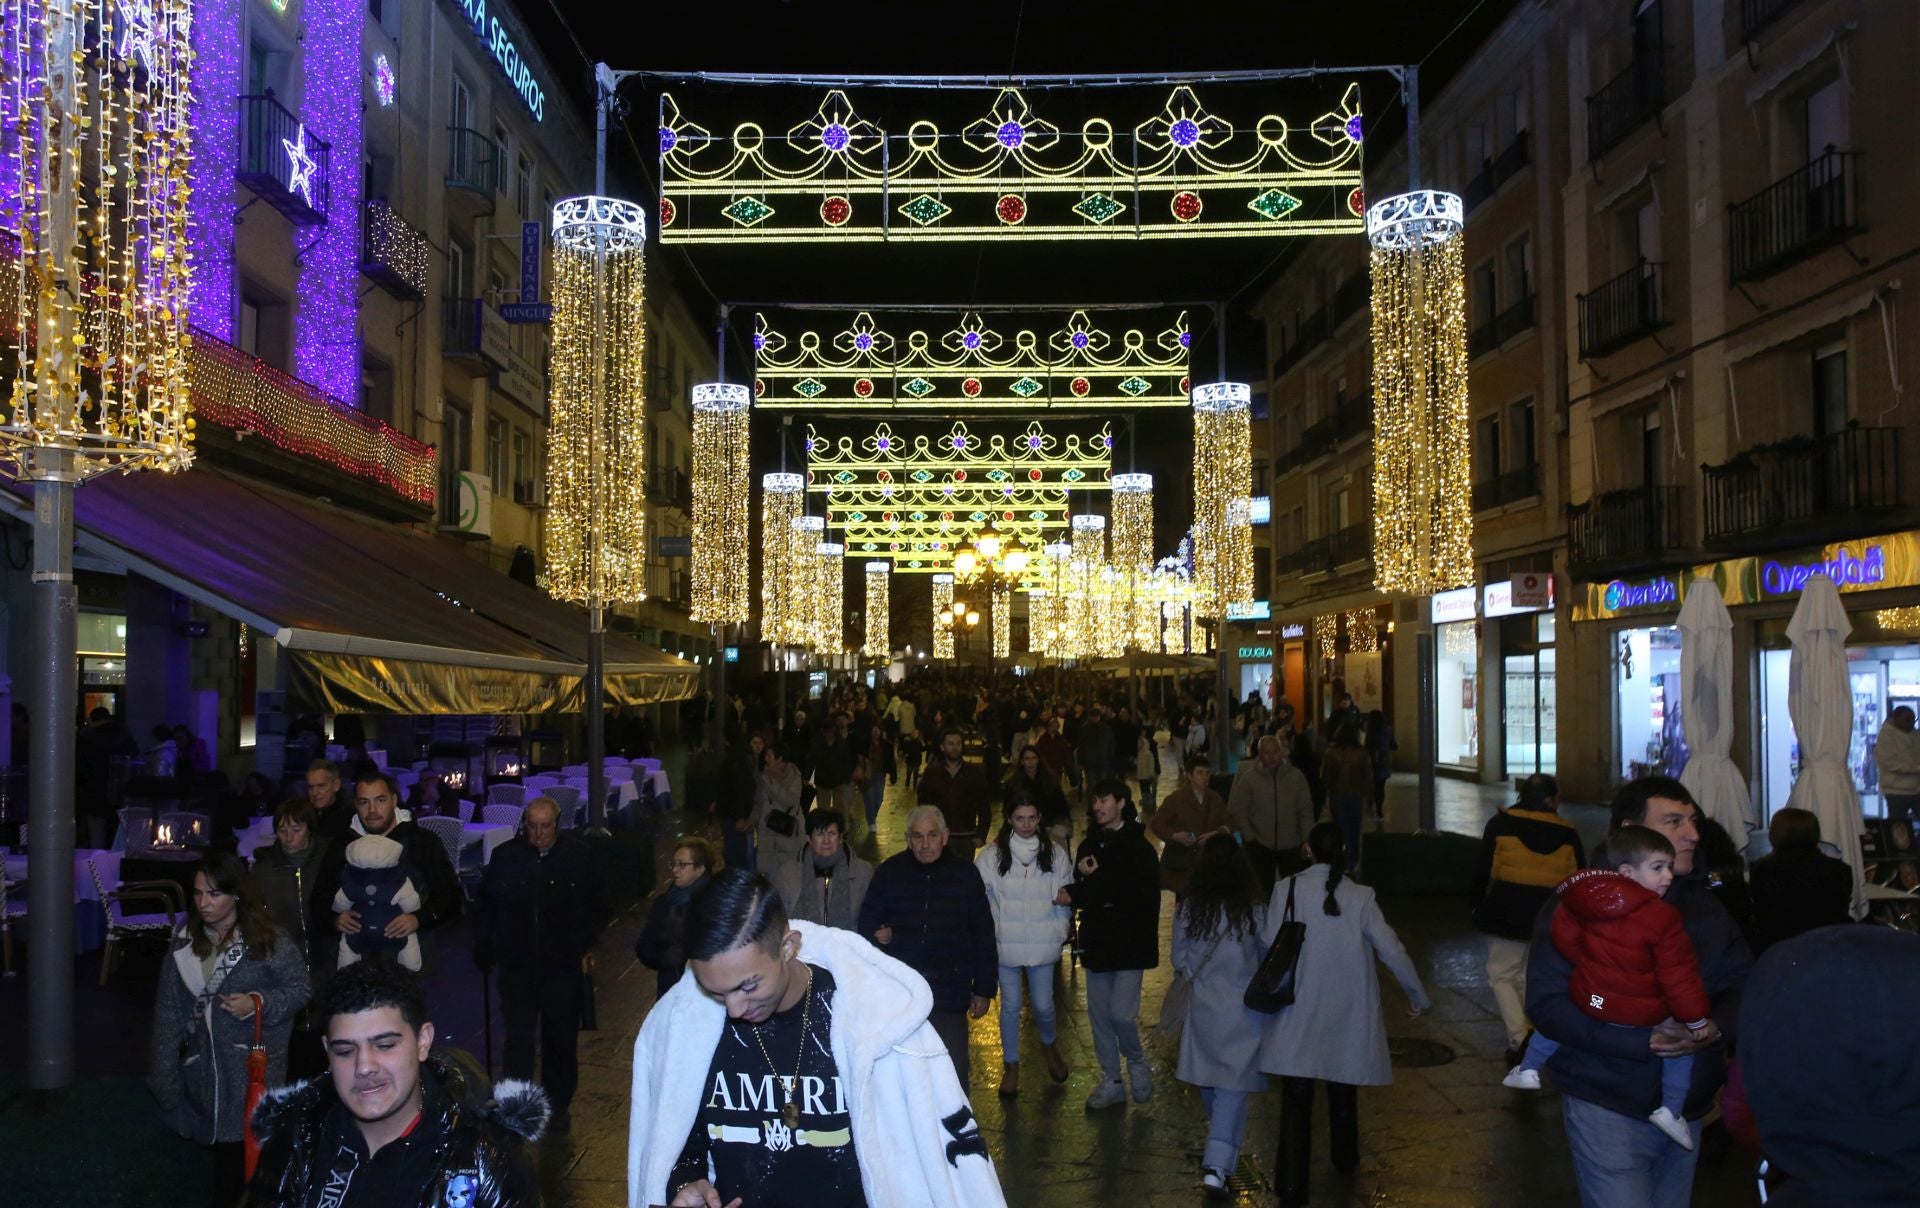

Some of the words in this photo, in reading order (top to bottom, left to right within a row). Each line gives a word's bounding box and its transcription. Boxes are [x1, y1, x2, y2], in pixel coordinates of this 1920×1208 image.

[489, 16, 545, 122] SEGUROS
[525, 226, 538, 301] OFICINAS
[503, 307, 552, 320] MINGUE
[706, 1070, 848, 1116] AMIRI
